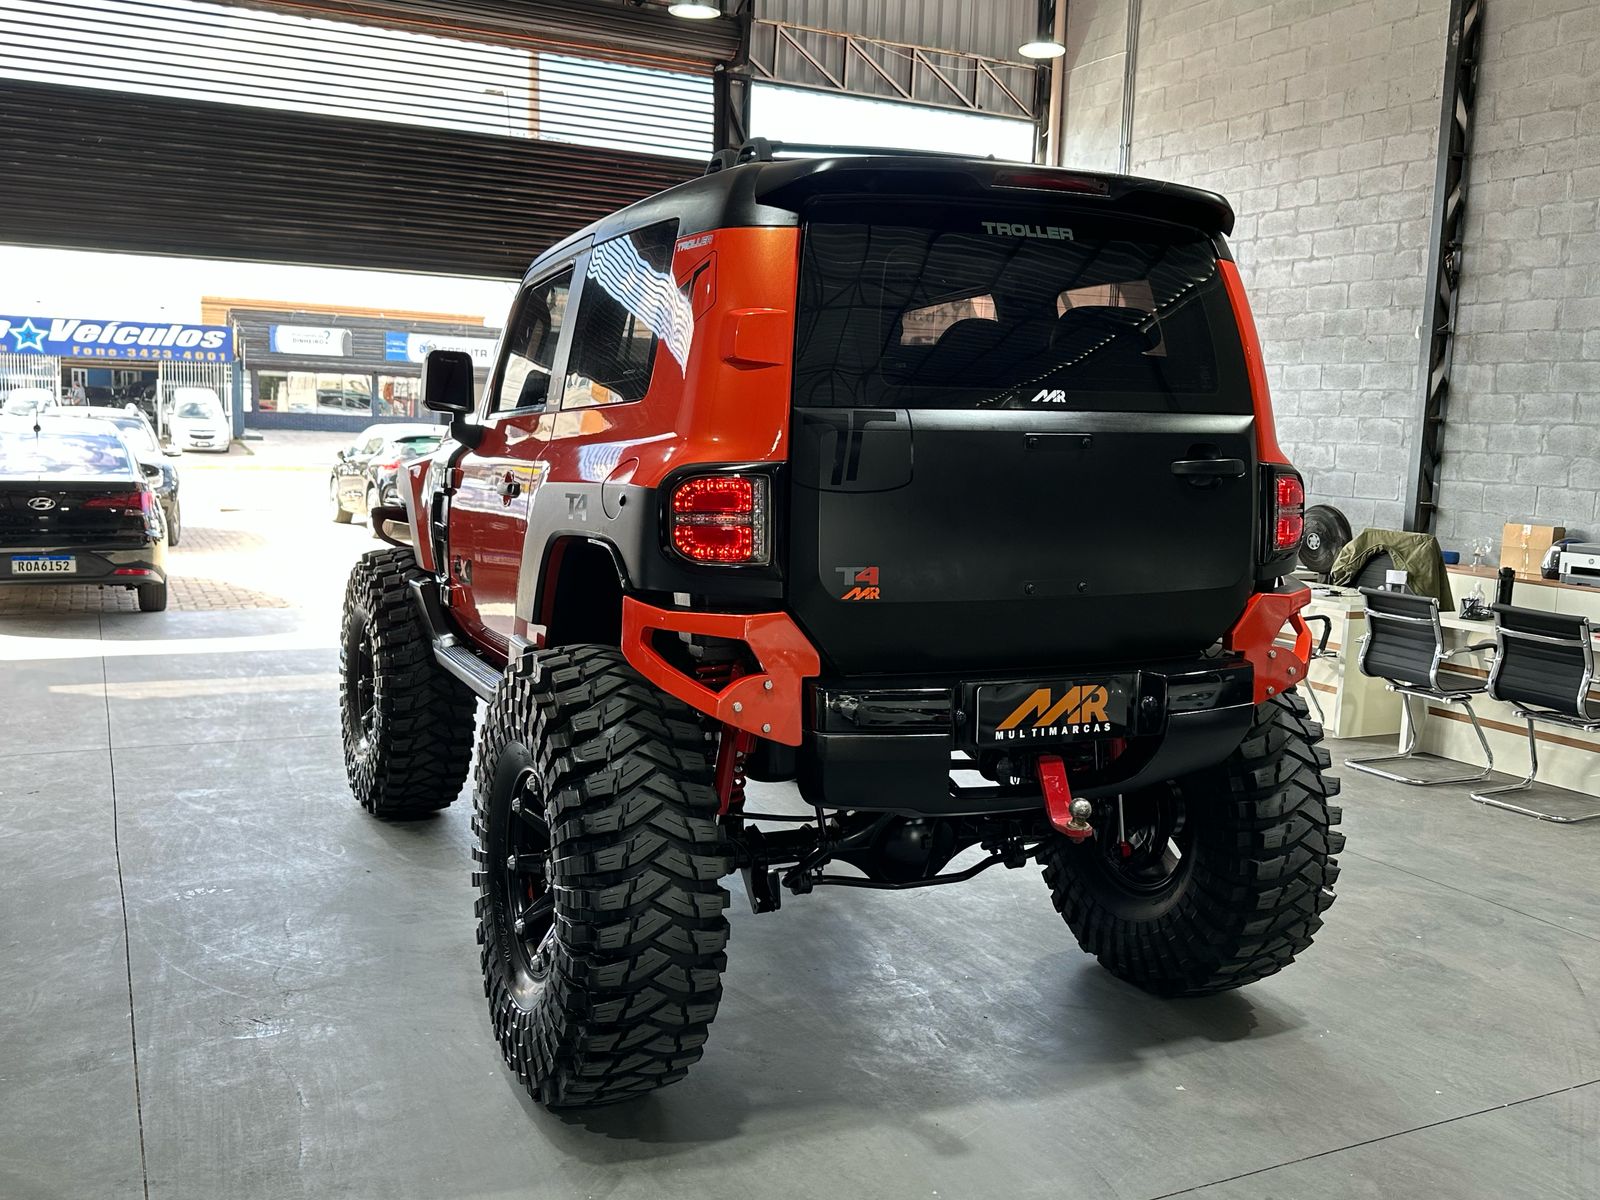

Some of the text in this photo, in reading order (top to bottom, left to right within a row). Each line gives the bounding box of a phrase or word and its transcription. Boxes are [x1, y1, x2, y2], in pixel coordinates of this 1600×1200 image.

[981, 221, 1074, 241] TROLLER
[677, 234, 714, 252] TROLLER
[47, 319, 227, 349] Veículos
[565, 493, 588, 521] T4
[18, 560, 70, 572] ROA6152
[835, 566, 880, 586] T4
[995, 722, 1111, 741] MULTIMARCAS
